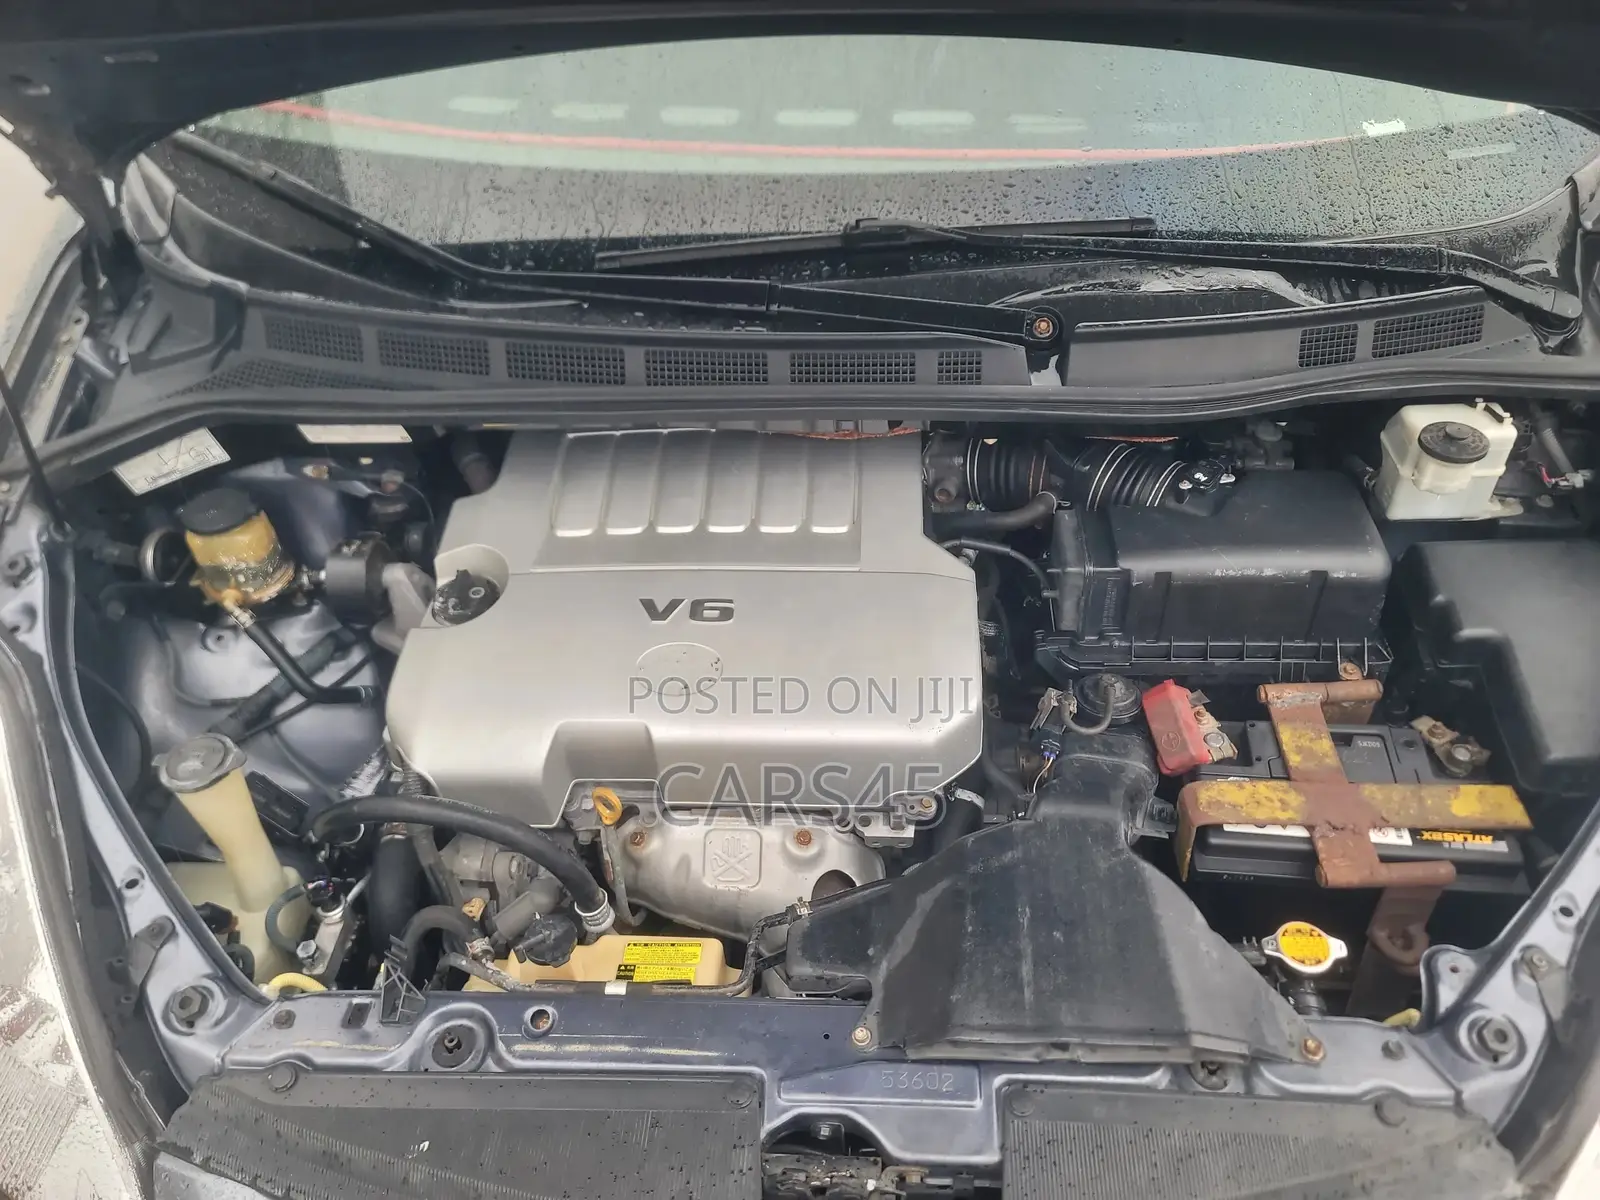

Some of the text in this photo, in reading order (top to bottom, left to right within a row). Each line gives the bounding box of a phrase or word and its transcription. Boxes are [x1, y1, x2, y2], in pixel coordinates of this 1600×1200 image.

[638, 598, 735, 623] V6
[1422, 831, 1492, 843] ATLASBX
[880, 1070, 954, 1091] 53602
